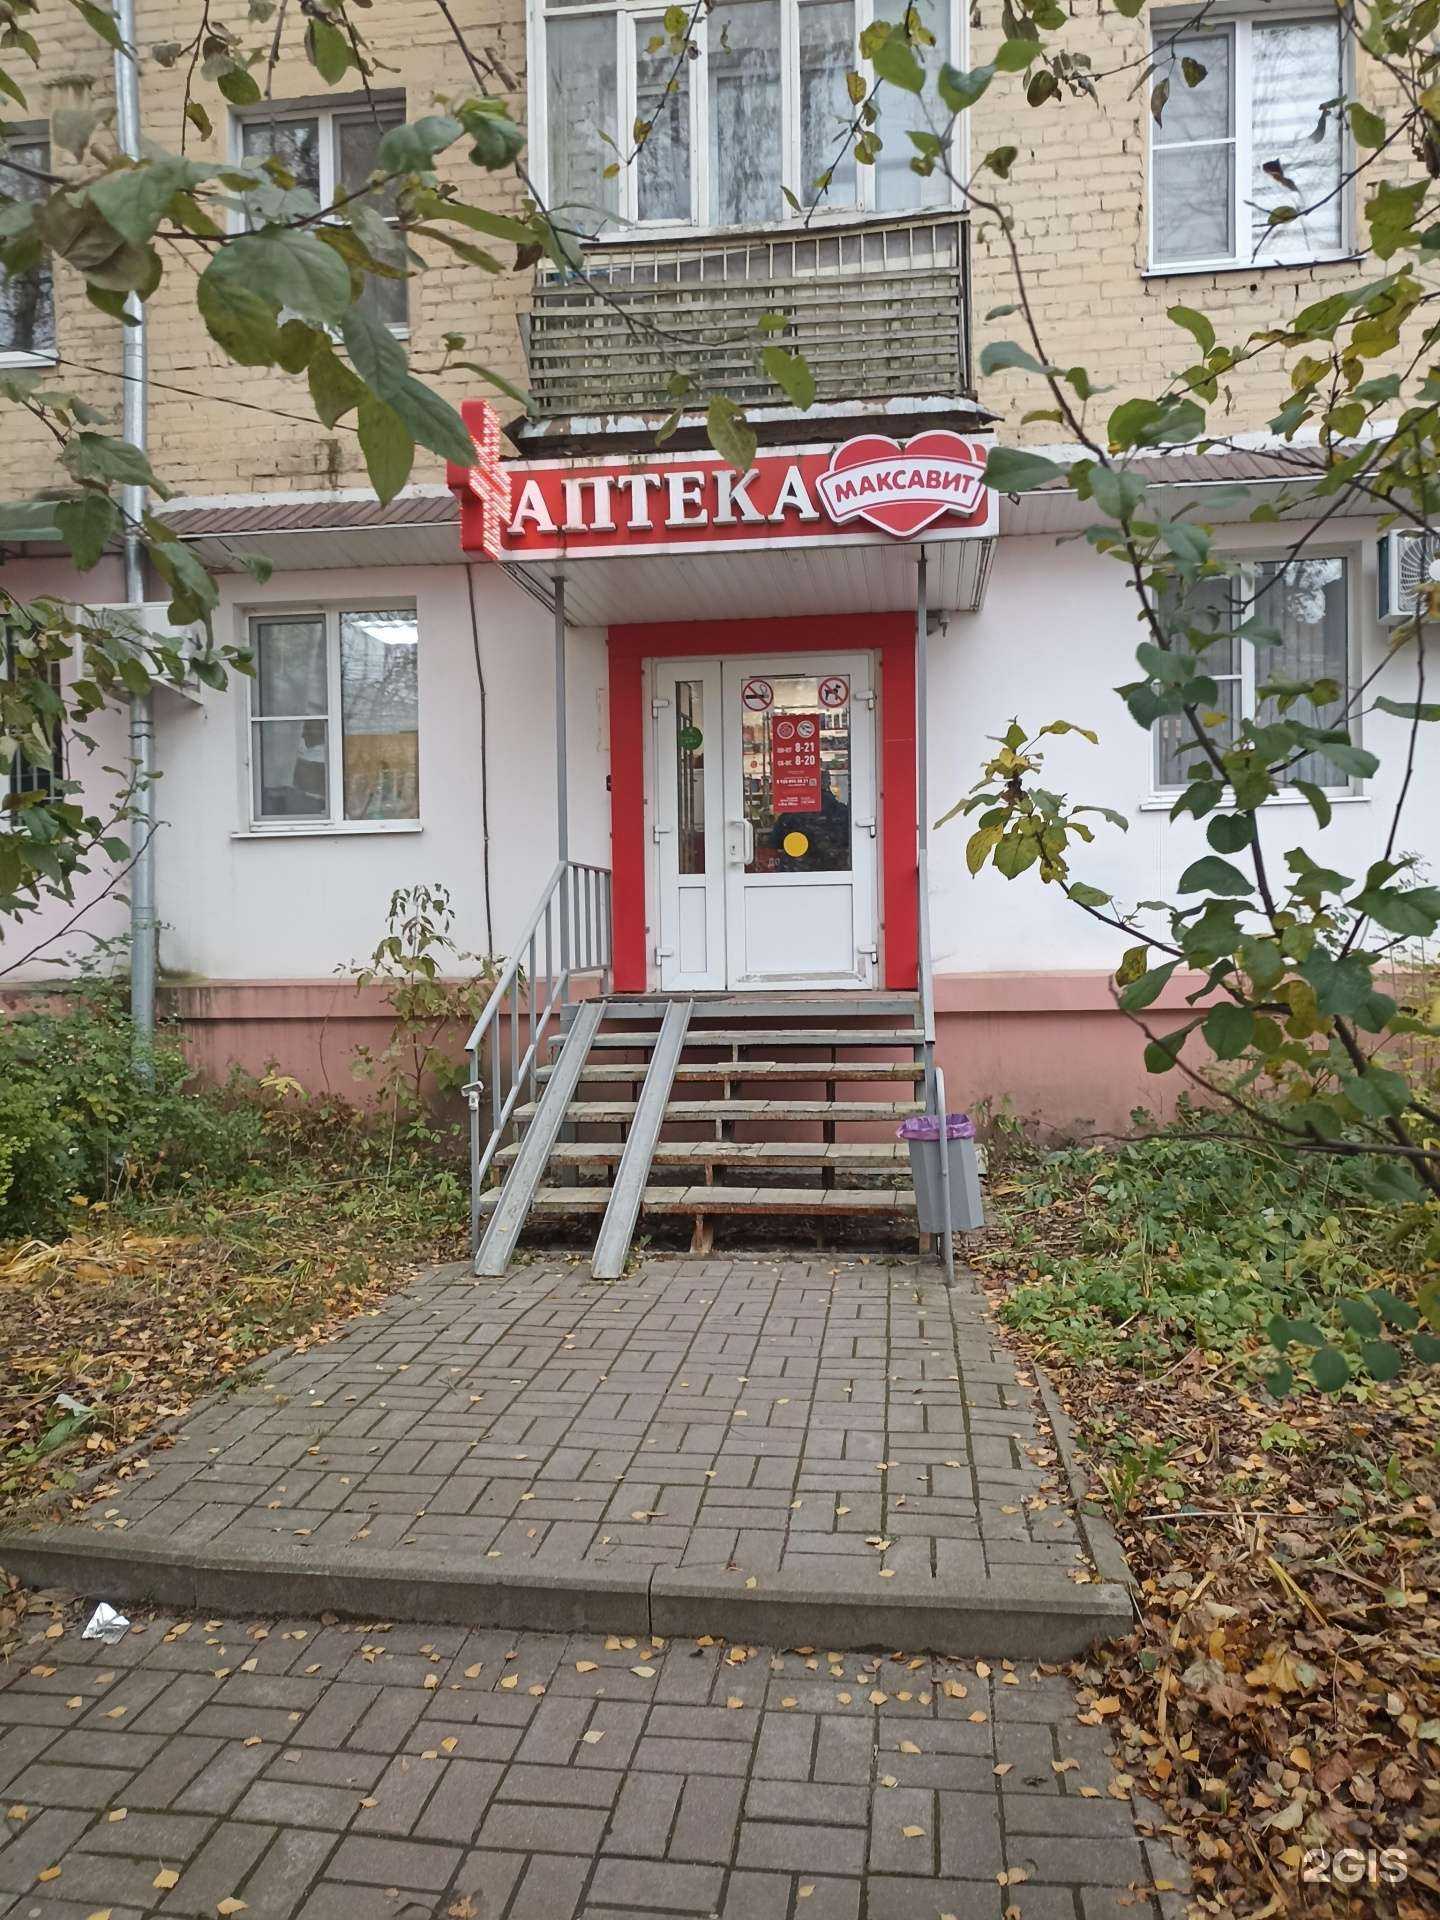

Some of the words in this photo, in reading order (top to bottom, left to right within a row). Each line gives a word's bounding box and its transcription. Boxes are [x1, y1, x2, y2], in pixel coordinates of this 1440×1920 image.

[834, 467, 976, 504] МАКСАВИТ
[506, 464, 820, 536] АПТЕКА
[795, 741, 815, 753] 8-21
[795, 755, 815, 766] 8-20
